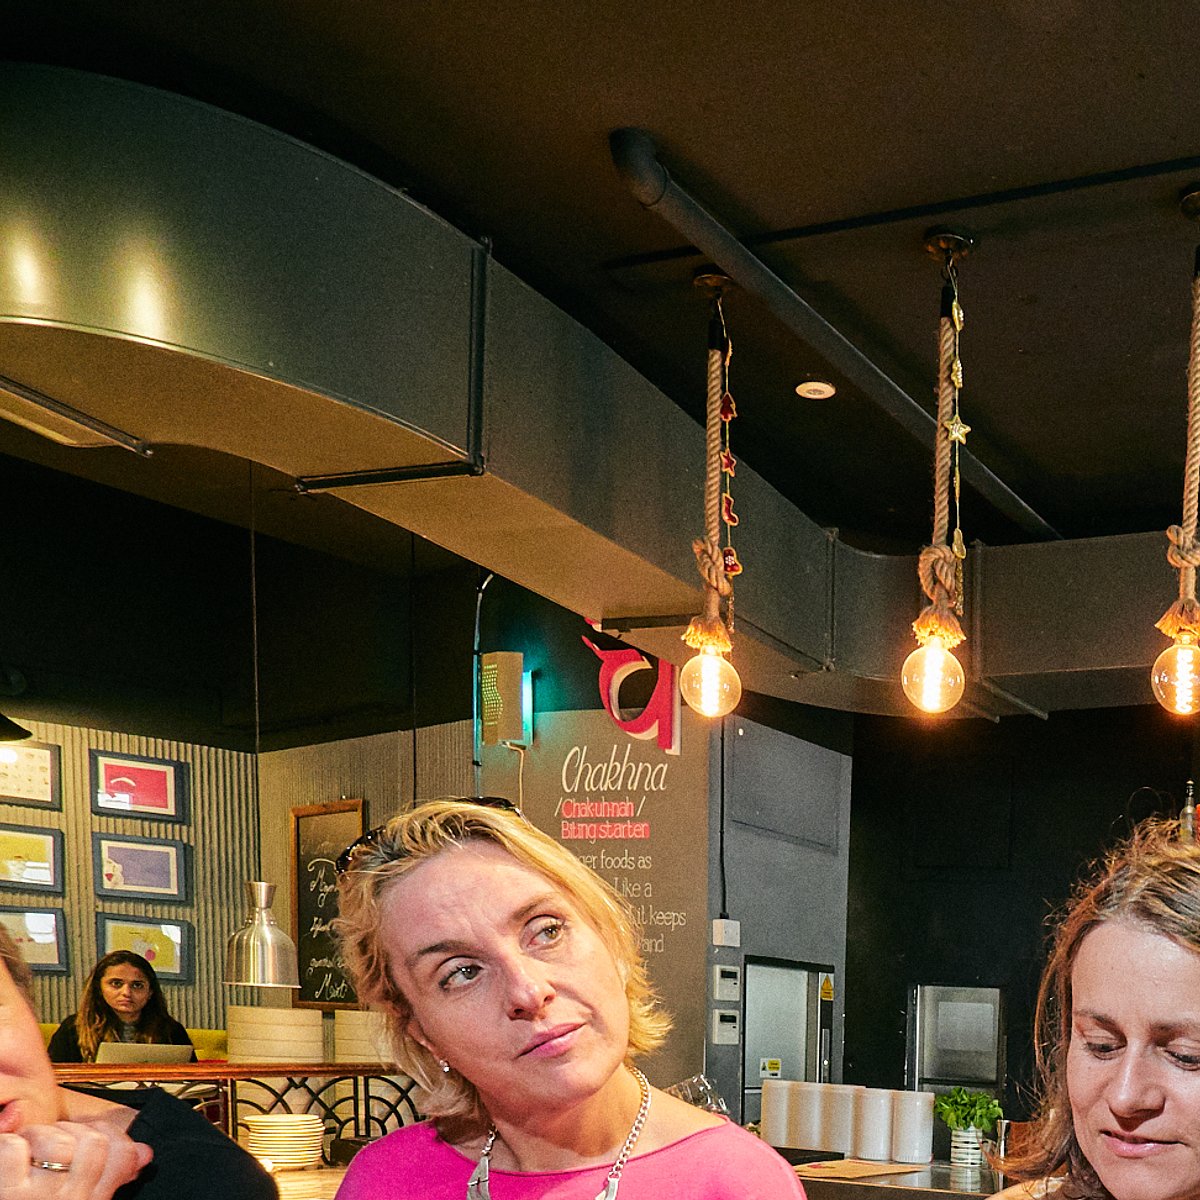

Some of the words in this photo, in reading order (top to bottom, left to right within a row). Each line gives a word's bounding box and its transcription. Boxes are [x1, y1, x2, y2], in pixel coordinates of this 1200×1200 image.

[561, 743, 669, 793] Chakhna
[599, 849, 635, 871] foods
[637, 855, 652, 870] as
[644, 882, 652, 898] a
[649, 904, 687, 931] keeps
